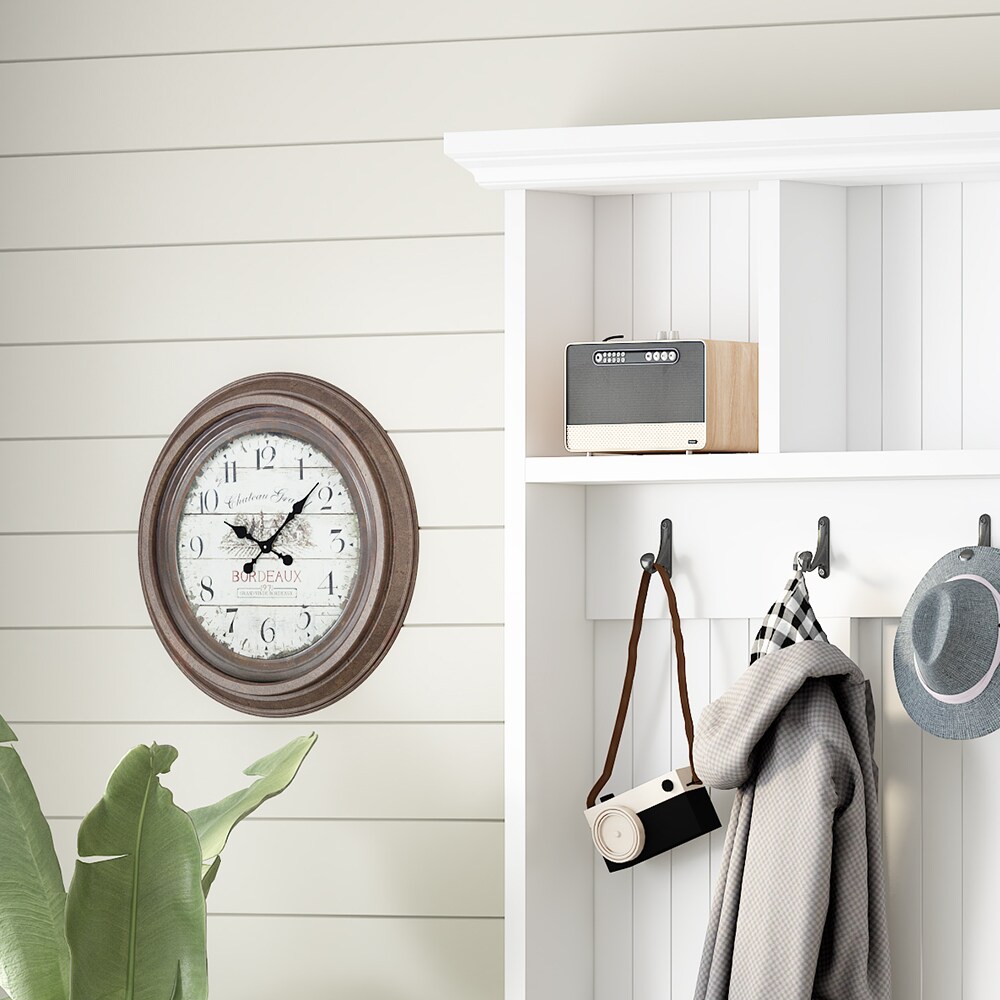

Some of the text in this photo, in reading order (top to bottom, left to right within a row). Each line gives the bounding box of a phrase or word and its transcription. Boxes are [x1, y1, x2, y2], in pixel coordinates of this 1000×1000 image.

[256, 445, 276, 470] 12
[299, 458, 304, 480] 1
[224, 460, 237, 483] 11
[199, 488, 219, 514] 10
[318, 486, 333, 511] 2
[190, 536, 203, 559] 9
[330, 529, 345, 553] 3
[200, 575, 214, 602] 8
[232, 570, 301, 583] BORDEAUX
[317, 571, 338, 595] 4
[226, 608, 238, 633] 7
[260, 617, 275, 643] 6
